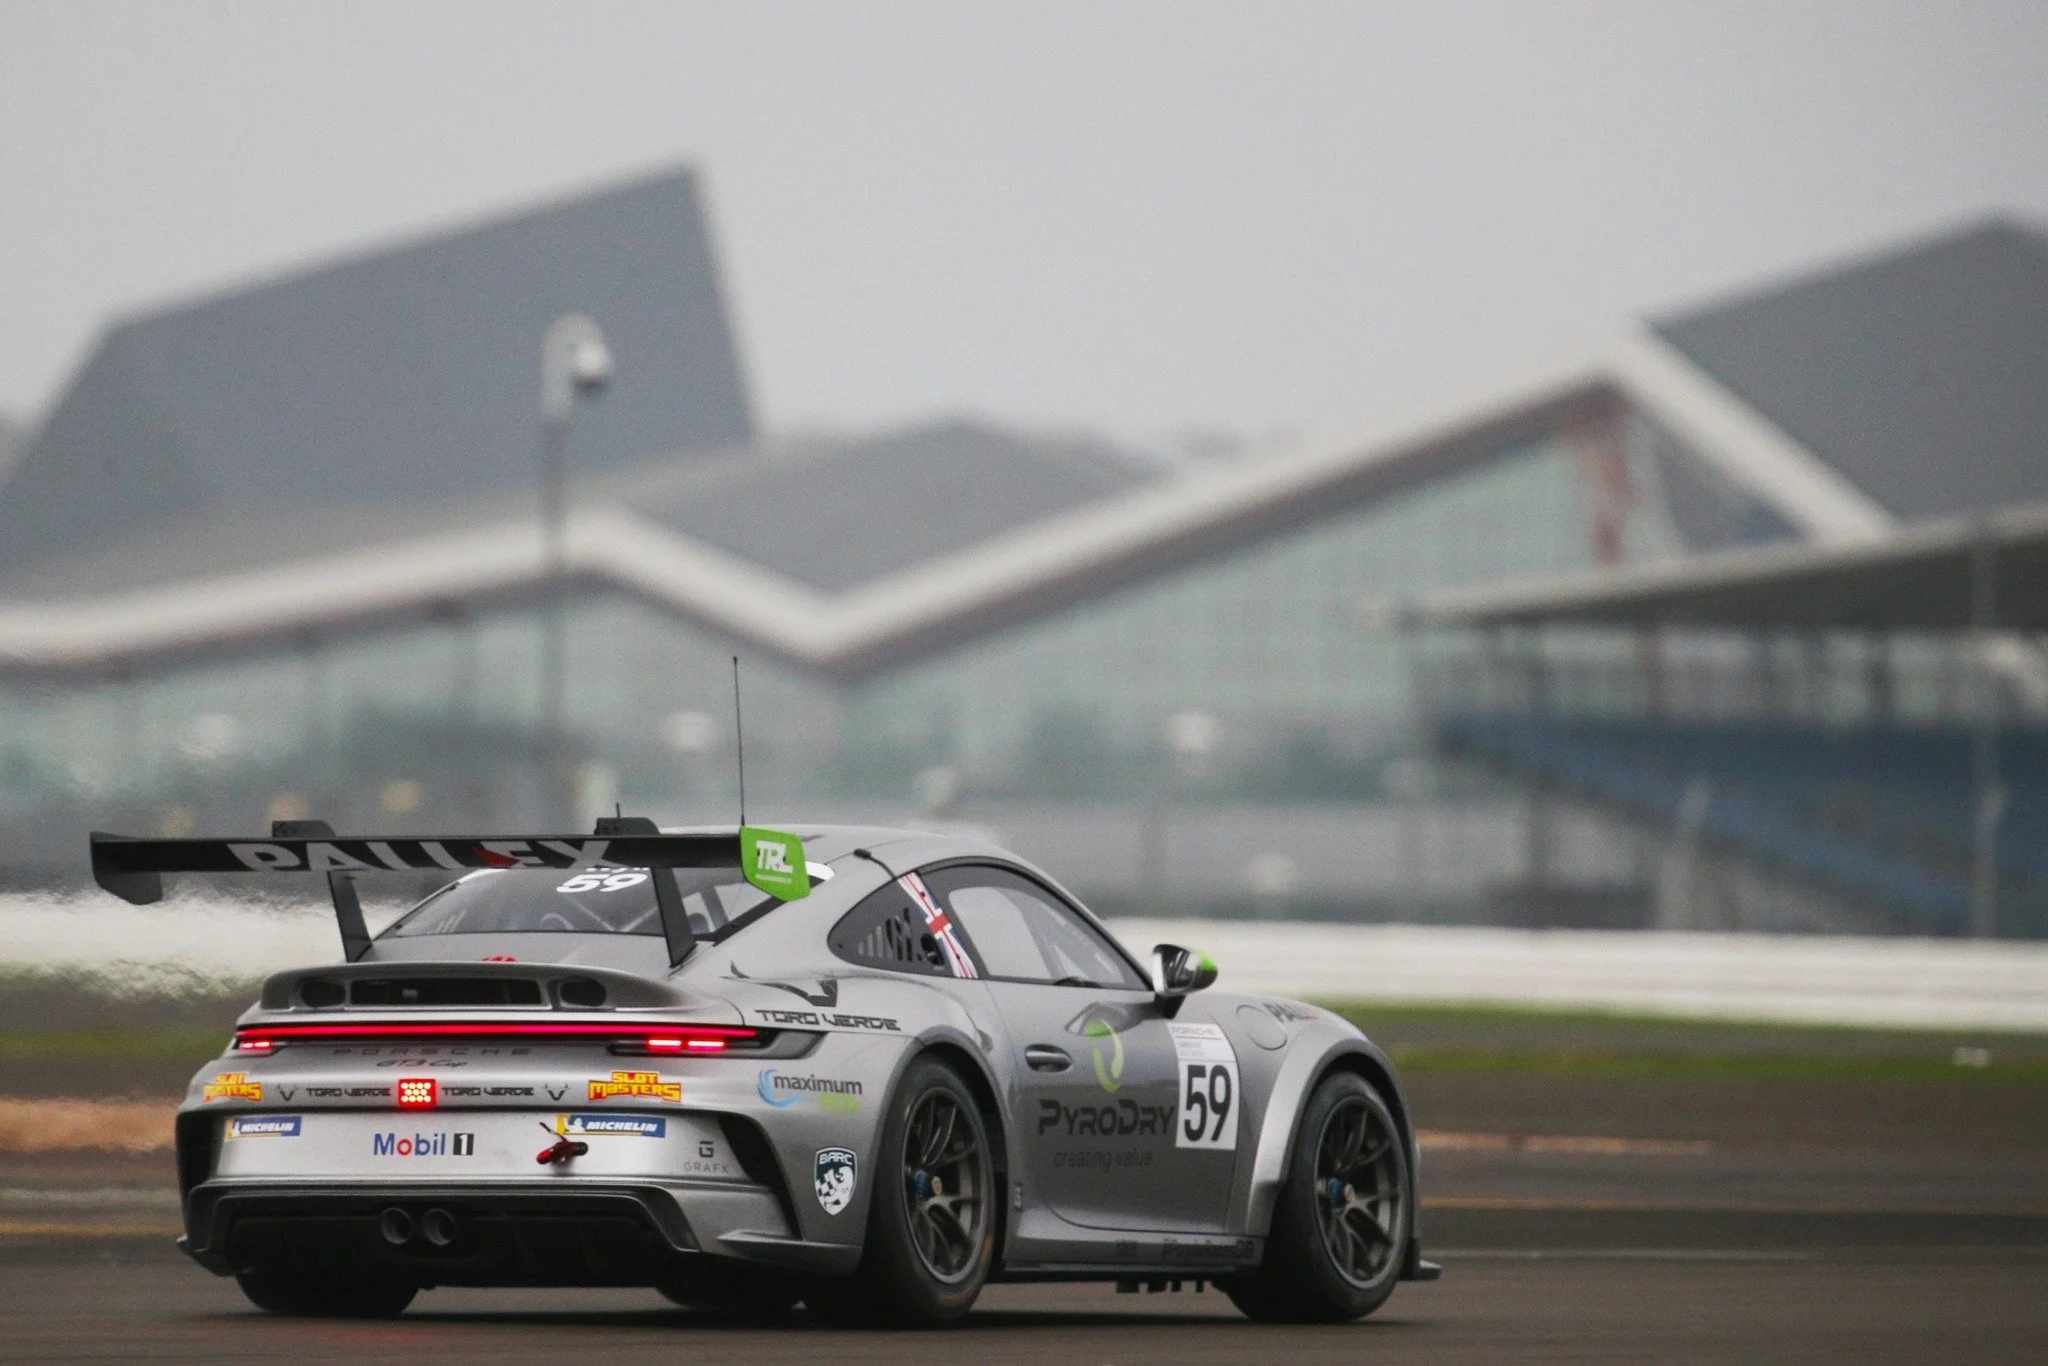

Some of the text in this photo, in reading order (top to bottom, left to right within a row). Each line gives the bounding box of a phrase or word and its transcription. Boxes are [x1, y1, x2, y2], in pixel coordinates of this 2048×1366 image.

[556, 873, 648, 893] 59
[755, 1009, 902, 1032] TORO VERDE
[611, 1072, 659, 1085] SLOT
[773, 1074, 863, 1095] maximum
[305, 1086, 392, 1097] TORO VERDE
[441, 1086, 535, 1097] TORO VERDE
[588, 1080, 682, 1103] MASTERS
[1184, 1064, 1232, 1143] 59
[585, 1120, 659, 1133] MICHELIN
[373, 1132, 446, 1156] Mobil
[818, 1152, 853, 1166] BARC
